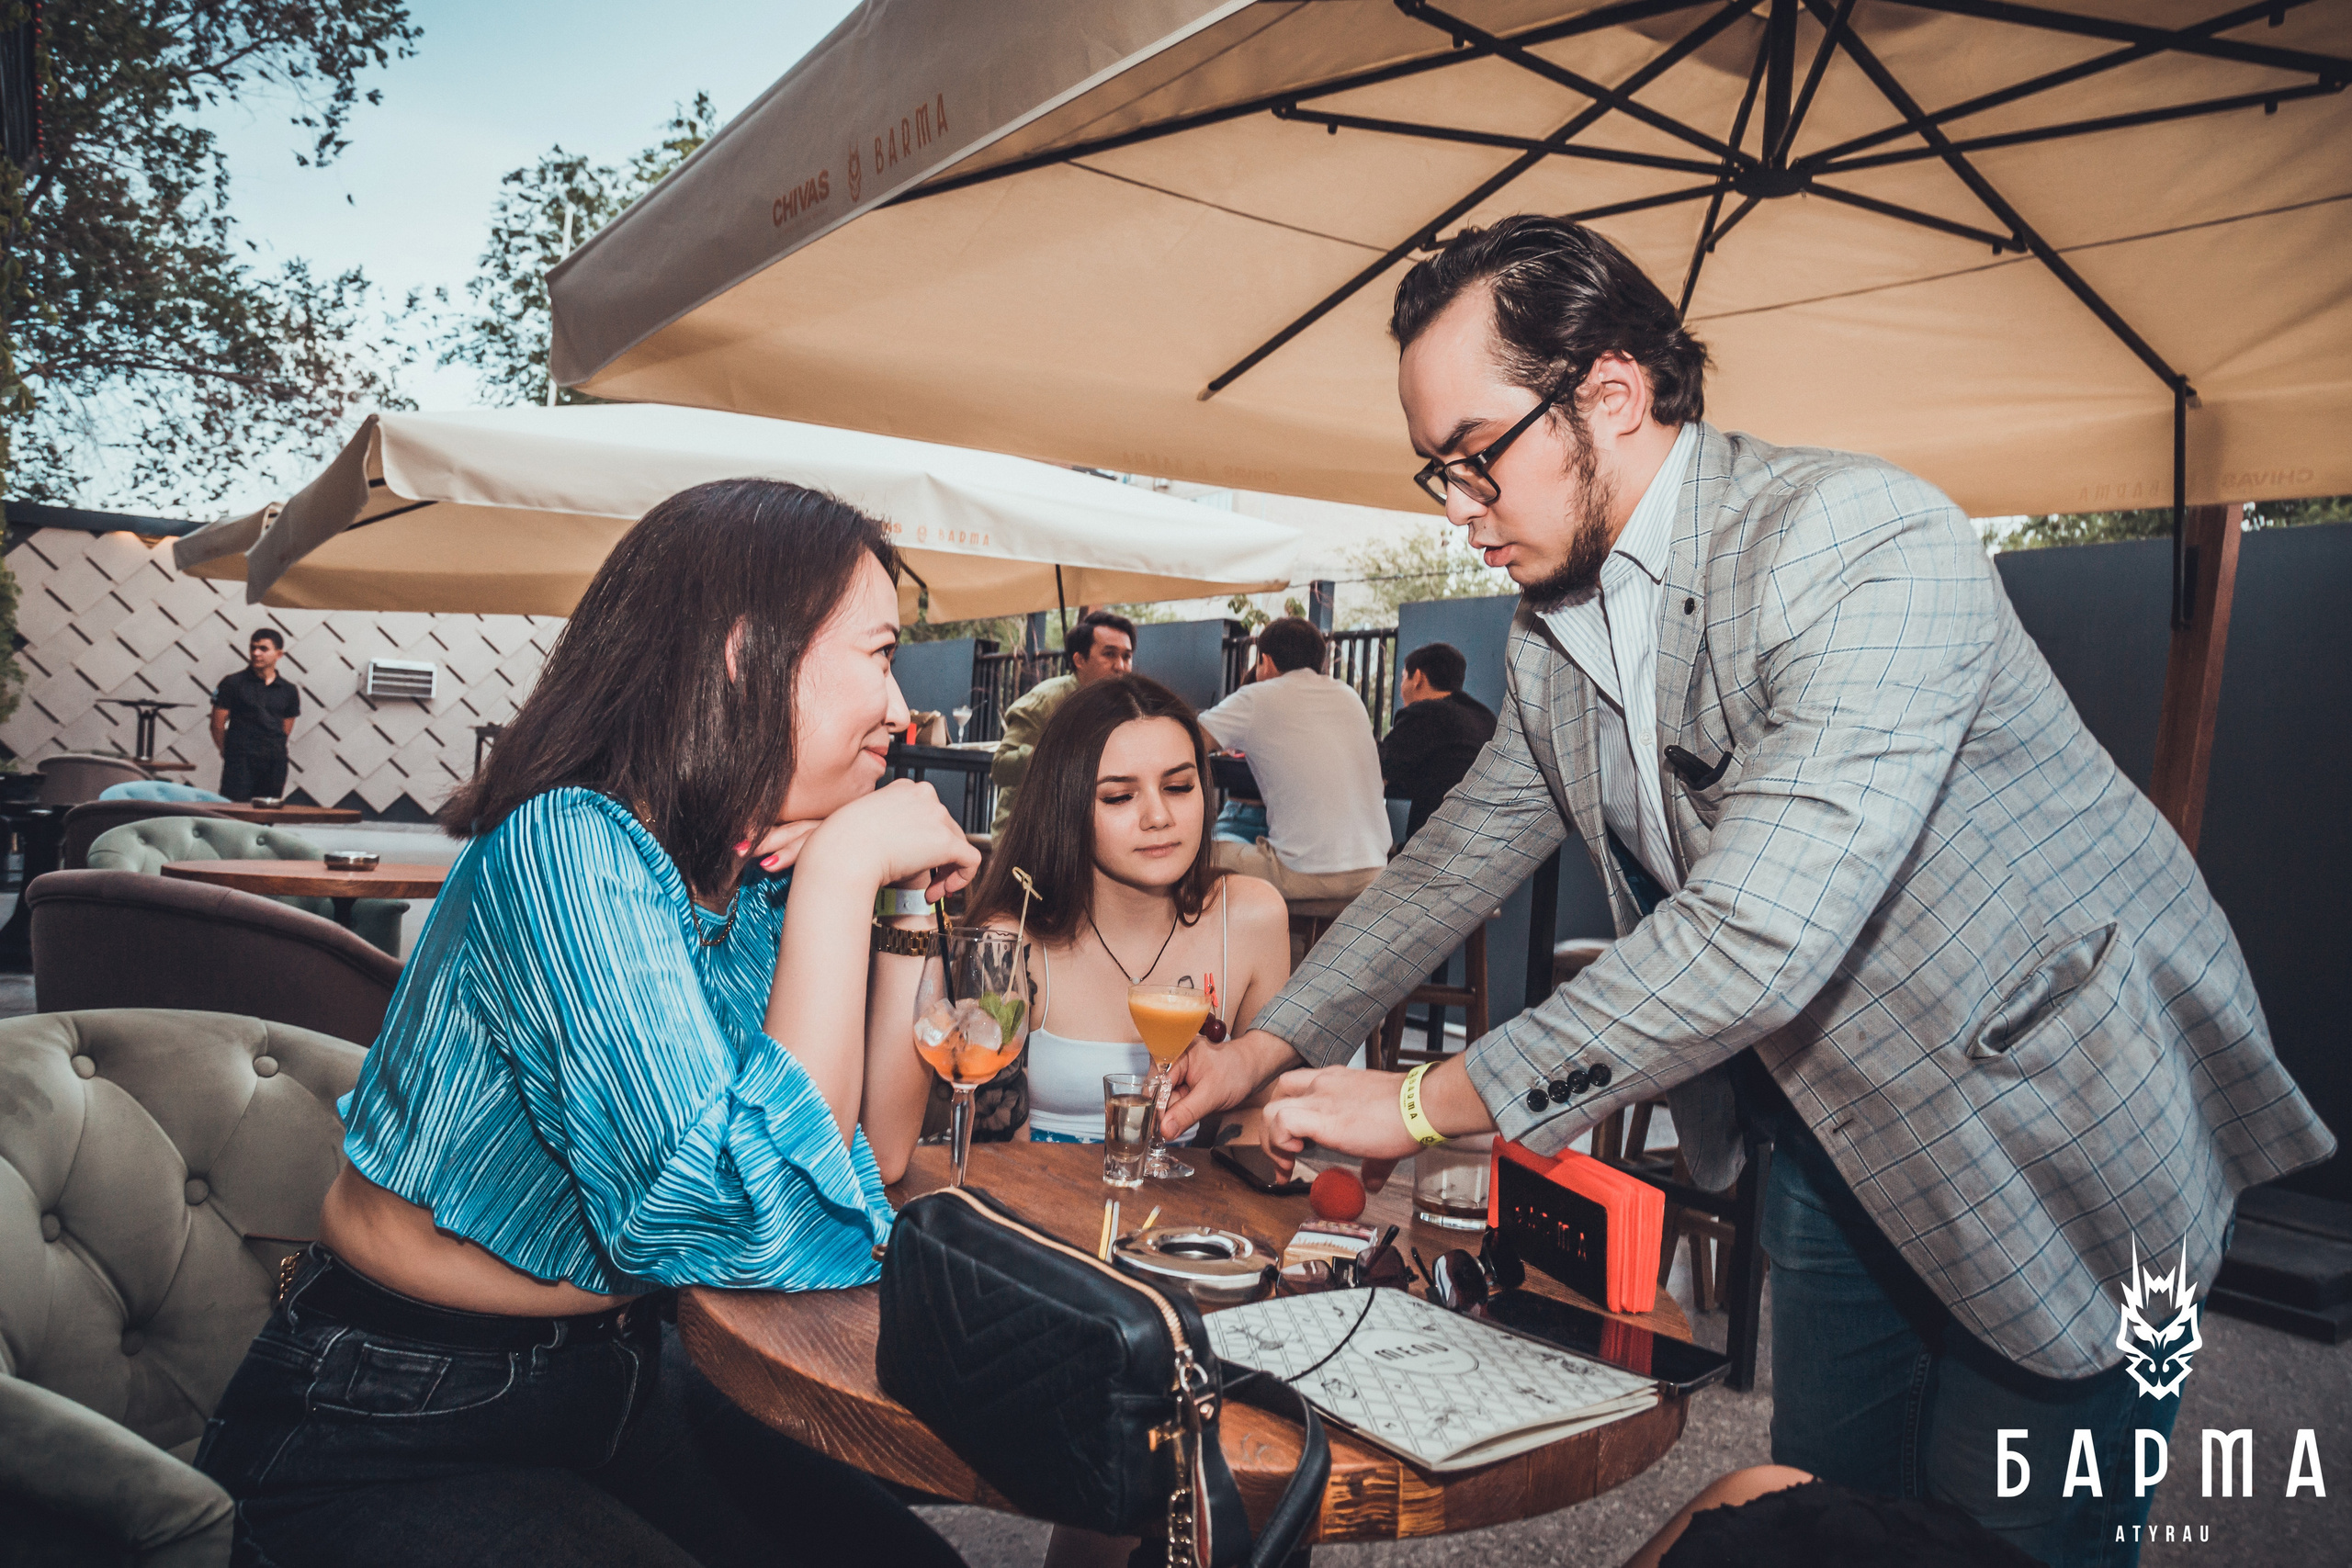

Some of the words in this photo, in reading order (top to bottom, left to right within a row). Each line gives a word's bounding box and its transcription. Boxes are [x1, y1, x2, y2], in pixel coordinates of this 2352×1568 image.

[773, 169, 830, 228] CHIVAS
[875, 93, 949, 174] BARMA
[1374, 1341, 1450, 1361] MENU
